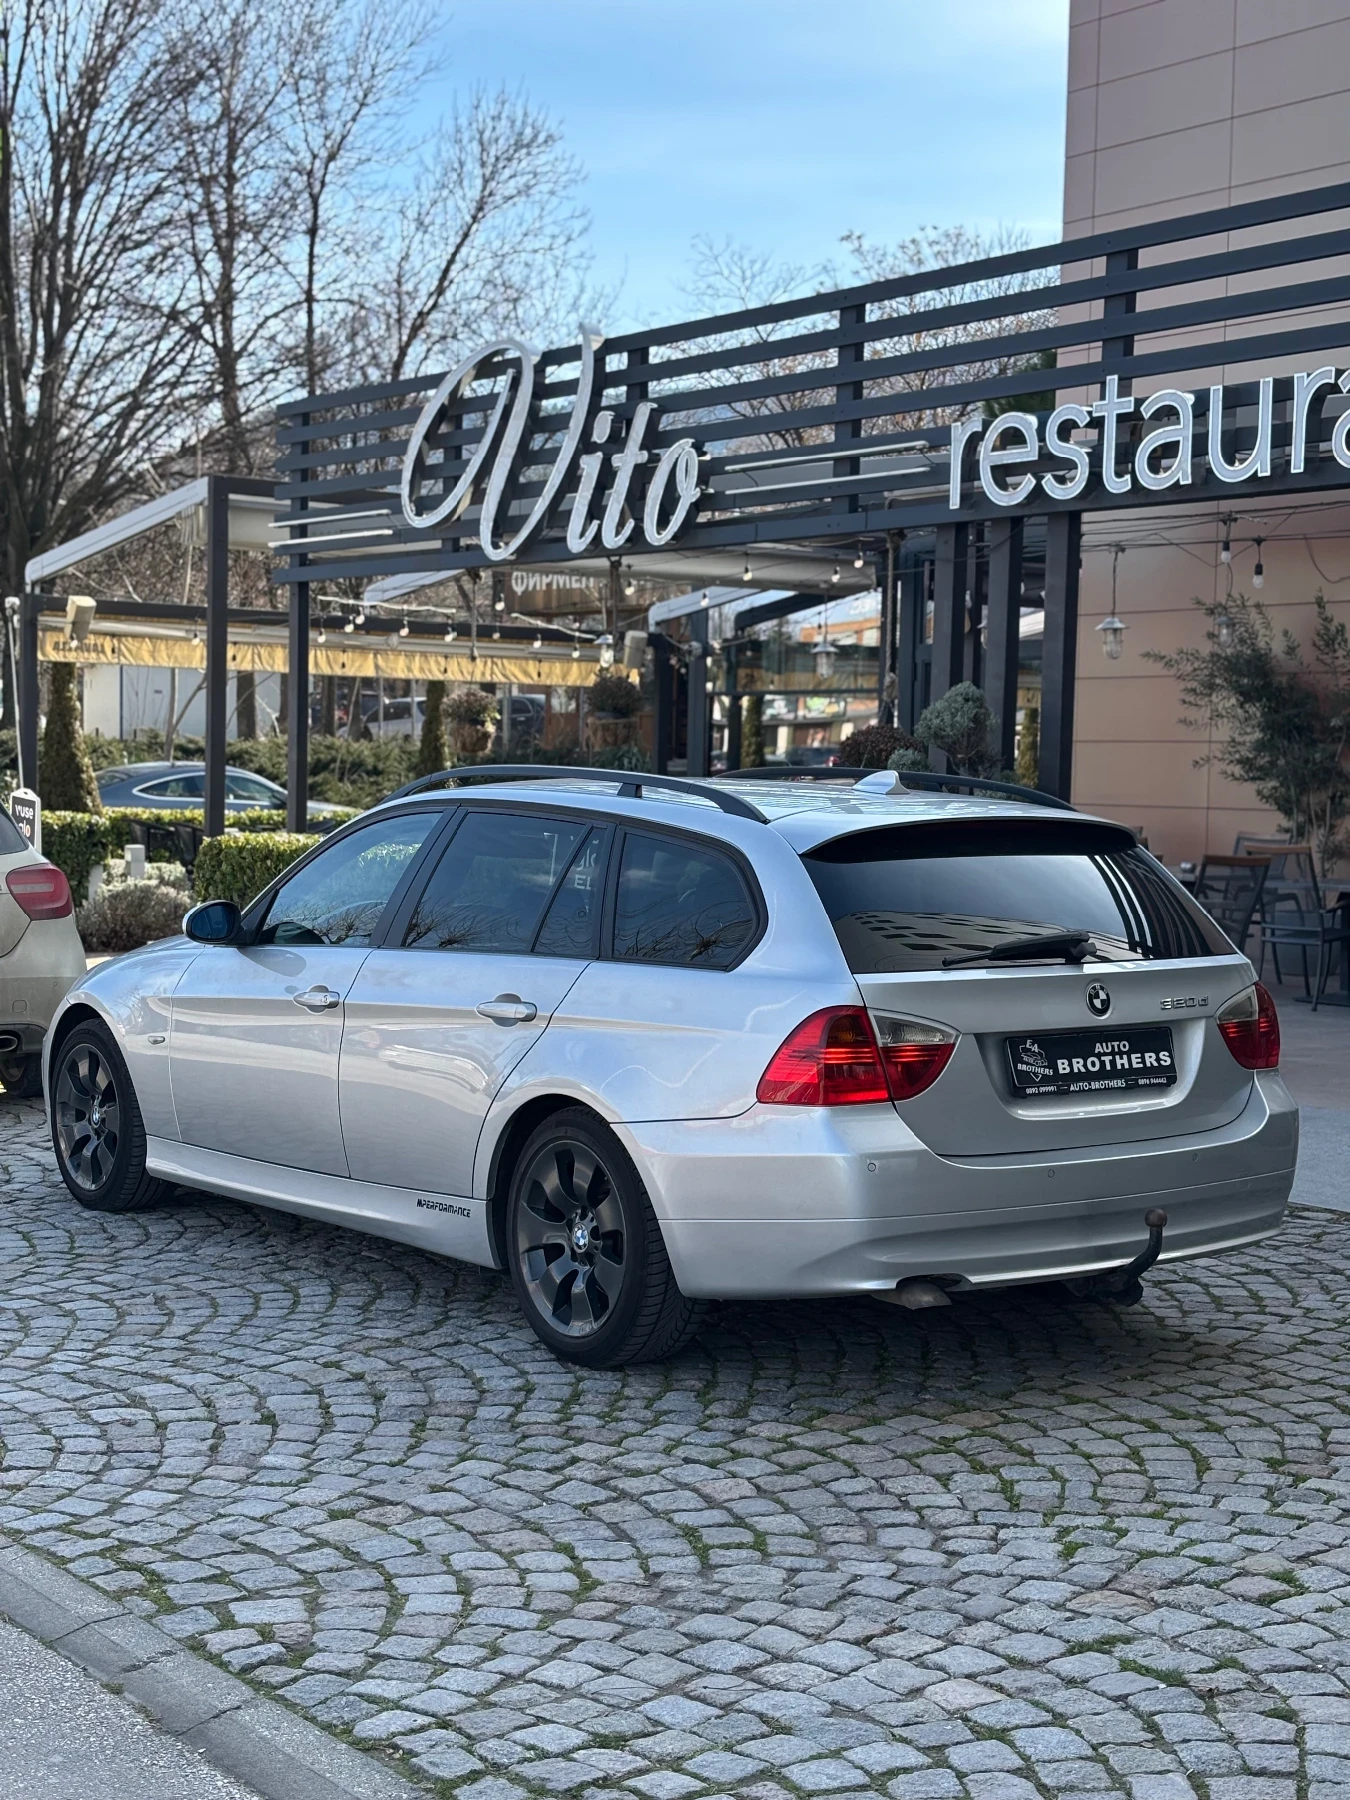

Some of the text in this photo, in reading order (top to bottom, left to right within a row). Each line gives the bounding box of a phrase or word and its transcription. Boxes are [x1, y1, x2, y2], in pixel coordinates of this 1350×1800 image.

[401, 322, 701, 562] Vito
[14, 804, 34, 820] vuse
[1160, 995, 1209, 1010] 320d
[1094, 1041, 1130, 1054] AUTO
[1017, 1063, 1054, 1076] BROTHERS
[1057, 1051, 1172, 1074] BROTHERS
[1069, 1079, 1126, 1091] AUTO-BROTHERS
